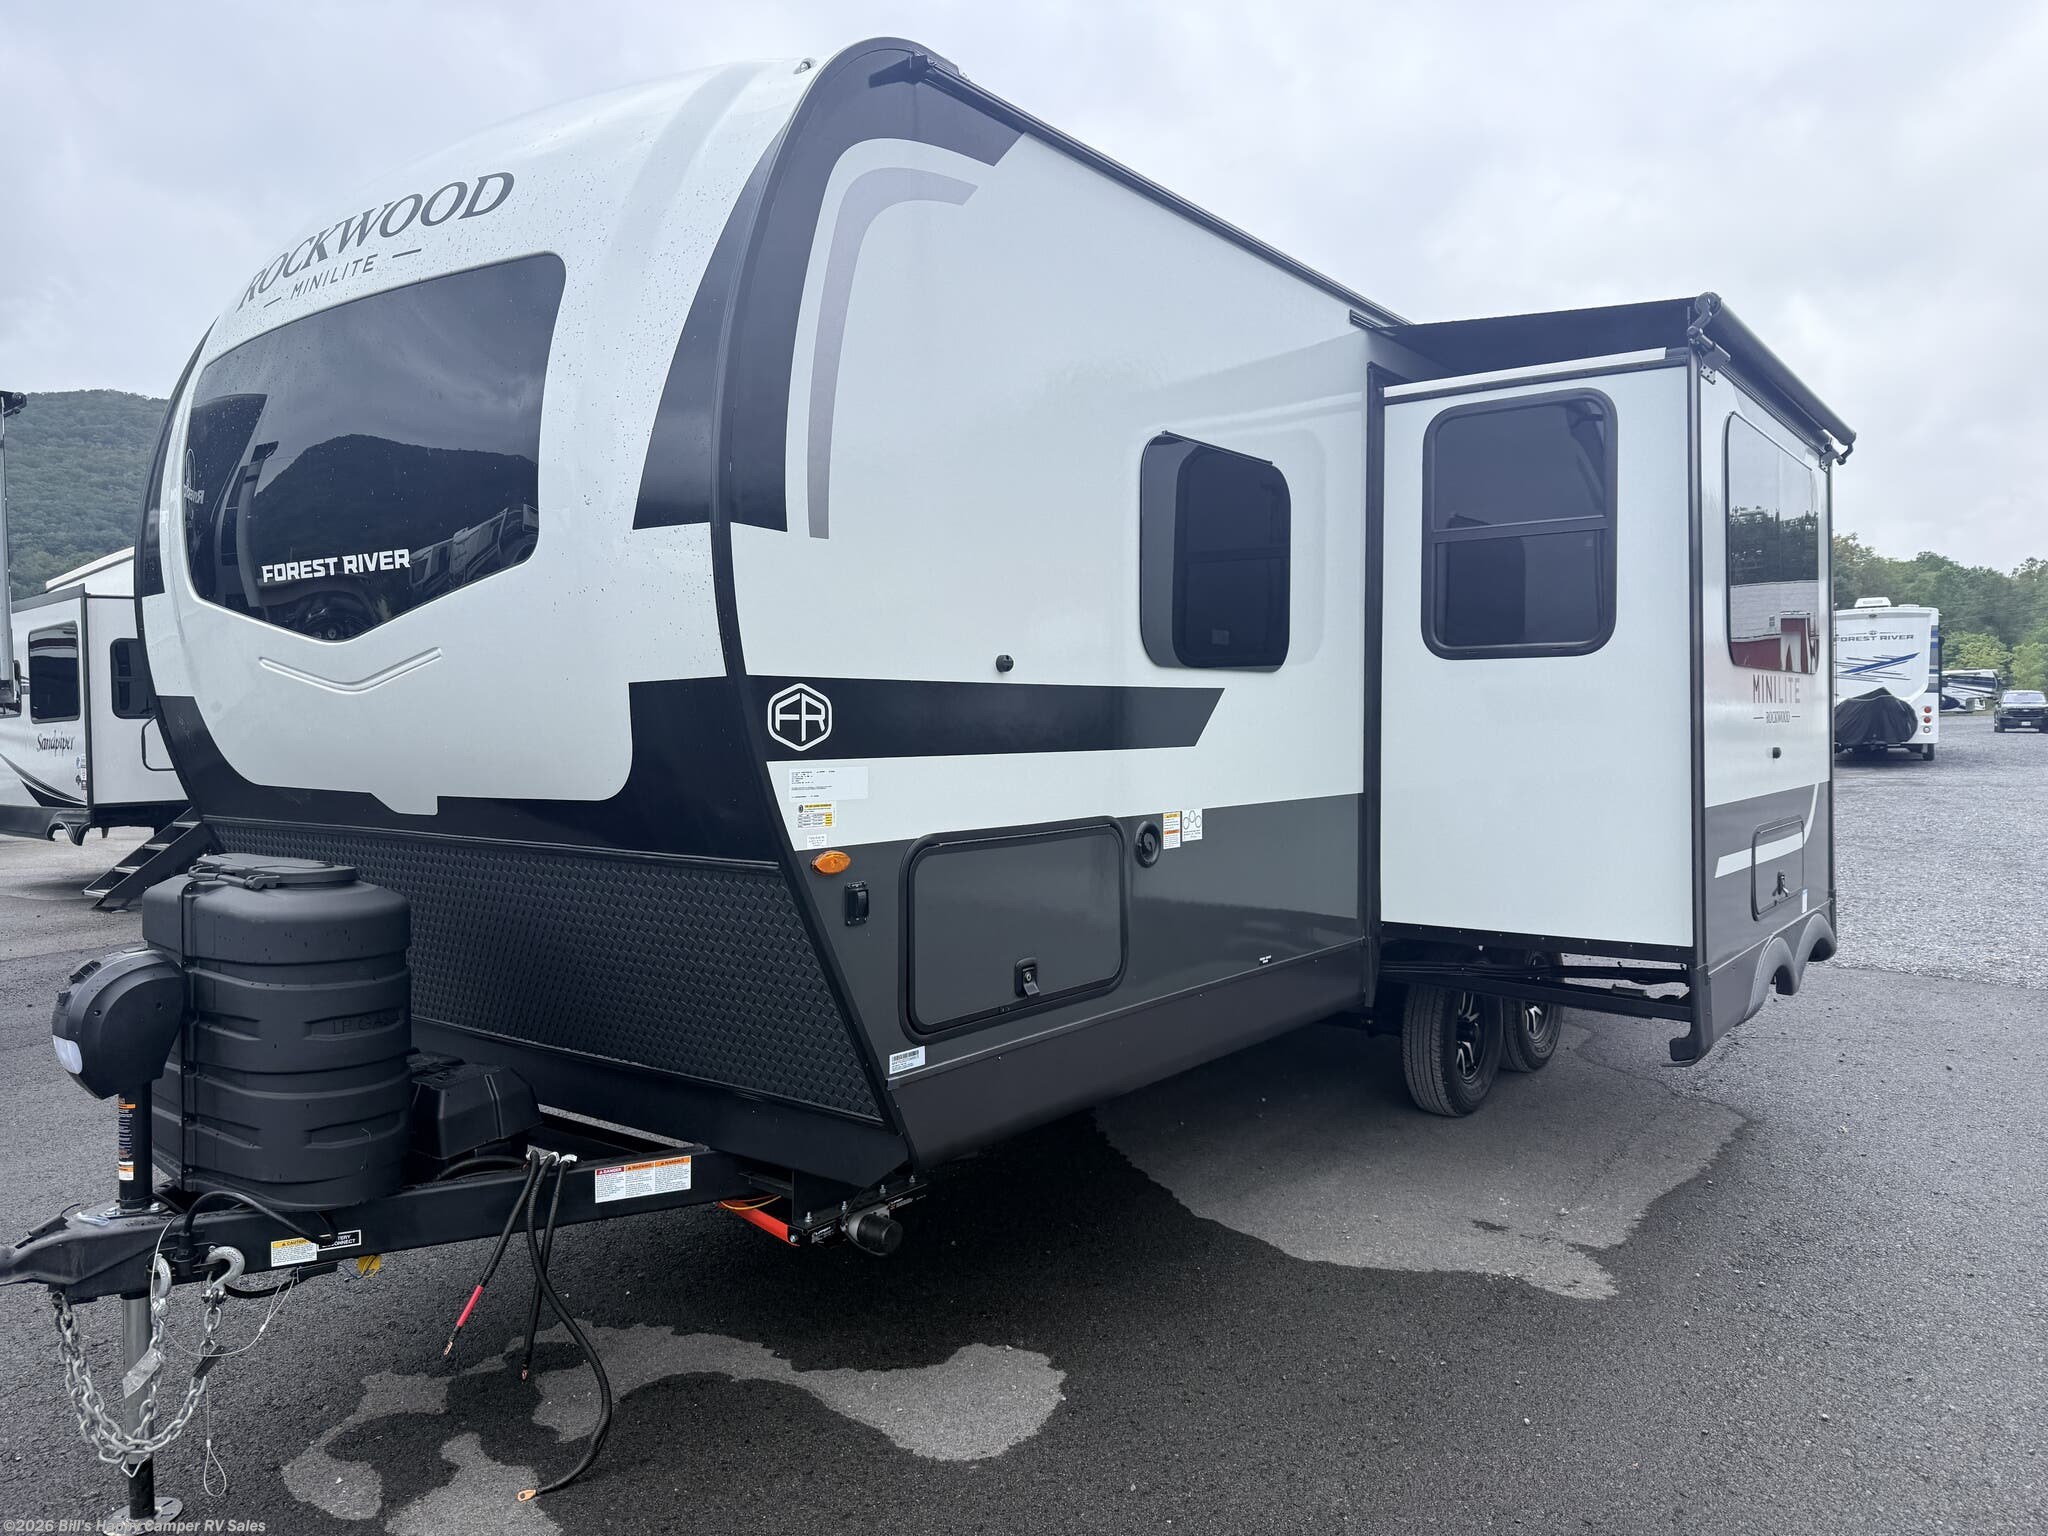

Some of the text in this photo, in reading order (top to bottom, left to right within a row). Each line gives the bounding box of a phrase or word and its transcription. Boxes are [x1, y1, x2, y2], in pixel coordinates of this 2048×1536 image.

[236, 172, 515, 313] ROCKWOOD
[291, 253, 379, 300] MINILITE
[261, 549, 412, 583] FOREST RIVER
[1752, 674, 1801, 704] MINILITE
[37, 730, 75, 758] Sandpiper
